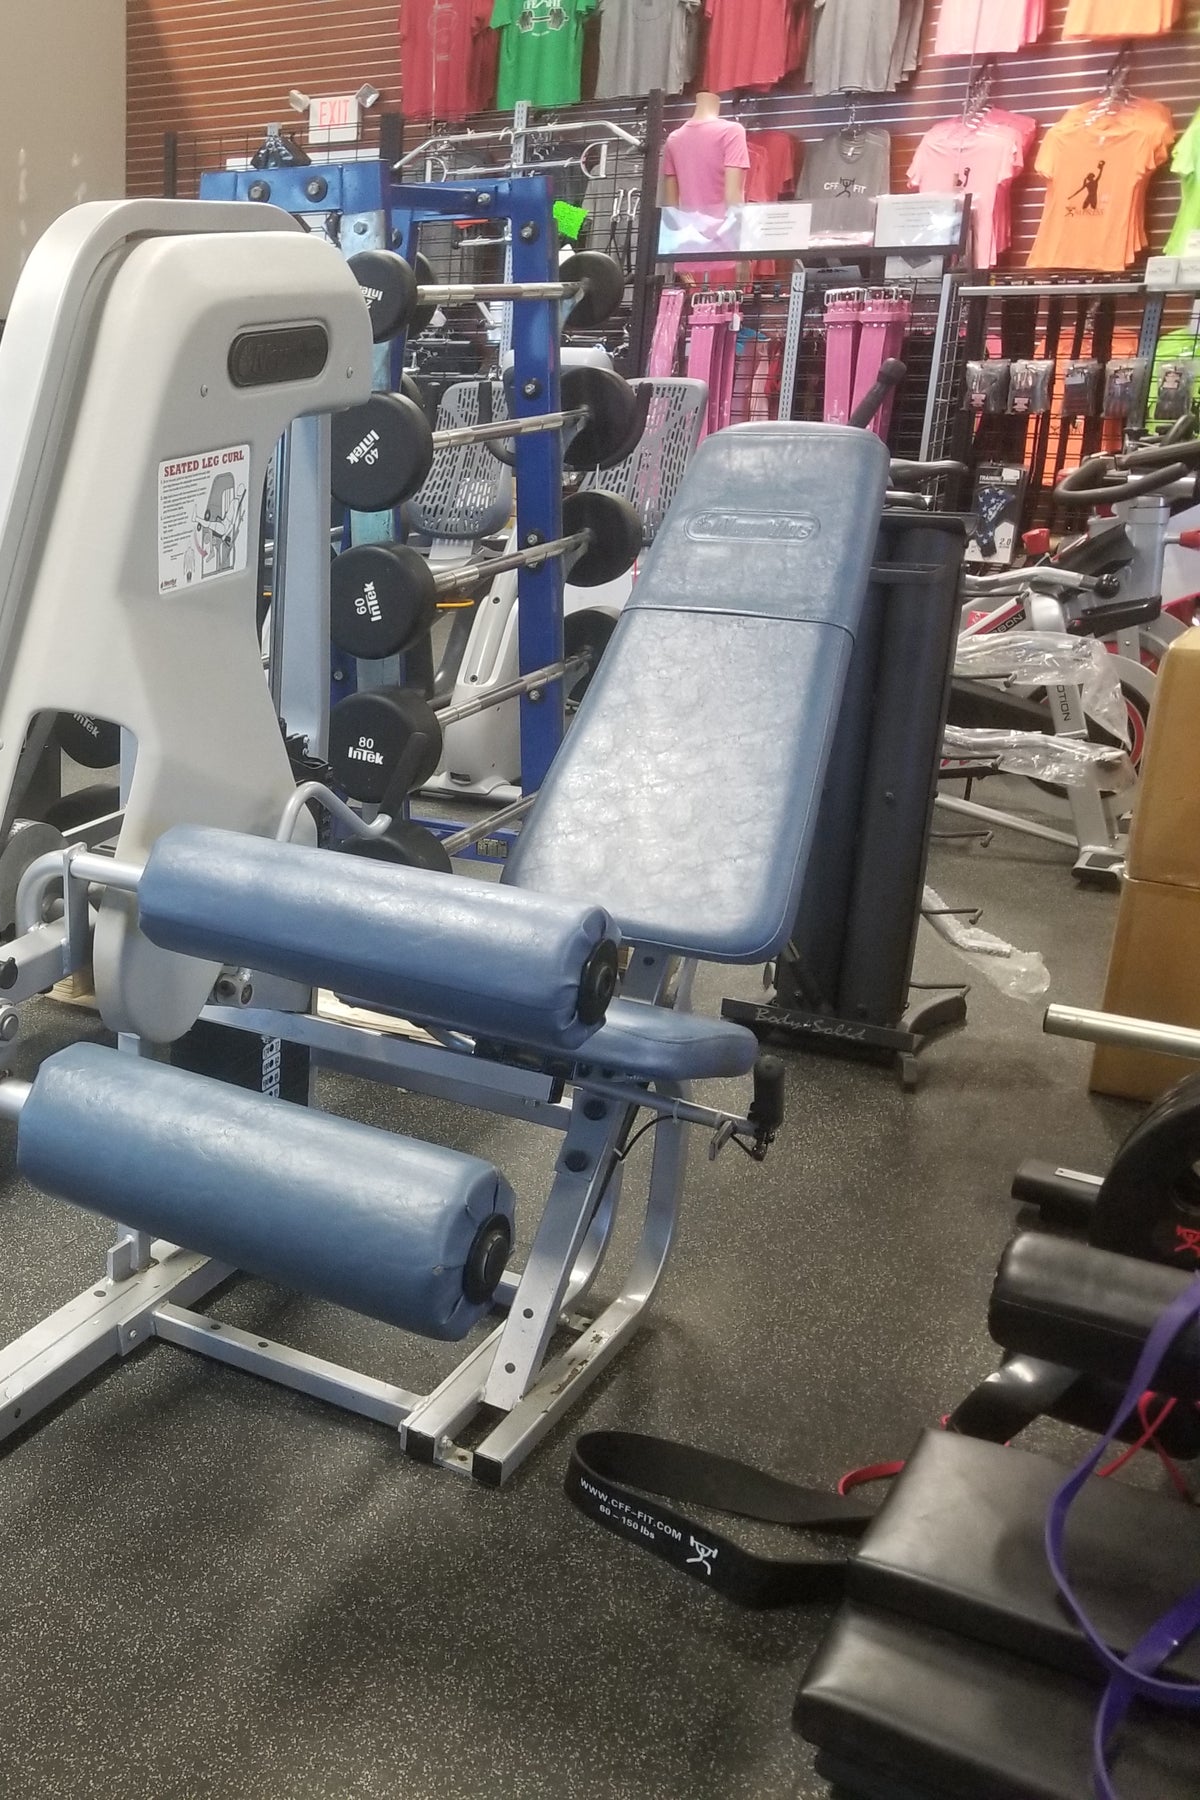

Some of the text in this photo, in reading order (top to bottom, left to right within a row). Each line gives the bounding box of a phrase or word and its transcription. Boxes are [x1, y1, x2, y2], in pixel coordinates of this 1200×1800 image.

[319, 100, 349, 126] EXIT
[360, 284, 383, 301] InTe
[346, 429, 380, 465] InTek
[365, 448, 379, 465] 40
[164, 450, 245, 477] SEATED LEG CURL
[364, 581, 382, 622] InTek
[992, 614, 1023, 633] BON
[358, 736, 375, 749] 80
[347, 746, 384, 765] InTek
[640, 1525, 656, 1540] lbs
